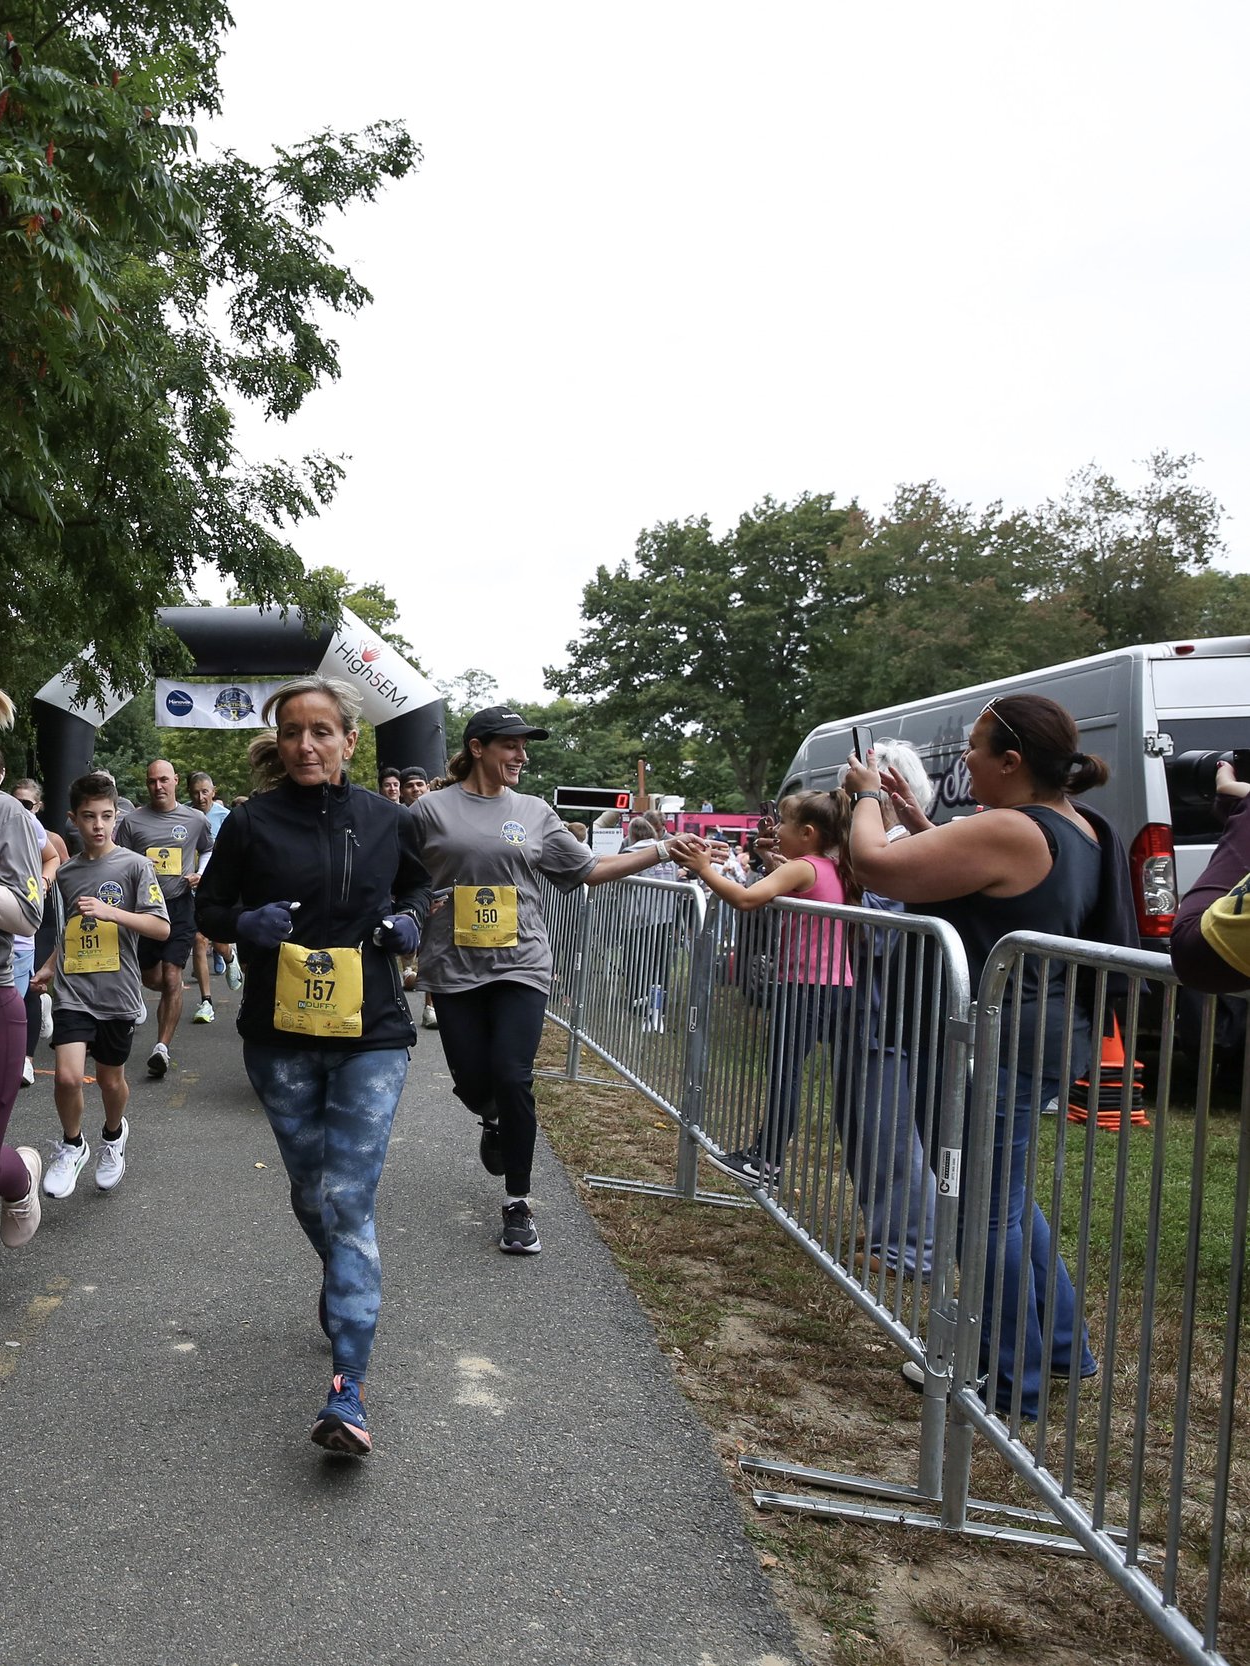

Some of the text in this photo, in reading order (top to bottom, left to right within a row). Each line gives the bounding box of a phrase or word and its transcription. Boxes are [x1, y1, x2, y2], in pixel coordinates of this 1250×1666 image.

[334, 641, 409, 709] High5EM
[616, 794, 629, 808] 0
[161, 860, 167, 869] 4
[475, 908, 498, 924] 150
[80, 934, 100, 949] 151
[303, 979, 336, 1001] 157
[306, 1000, 337, 1010] DUFFY
